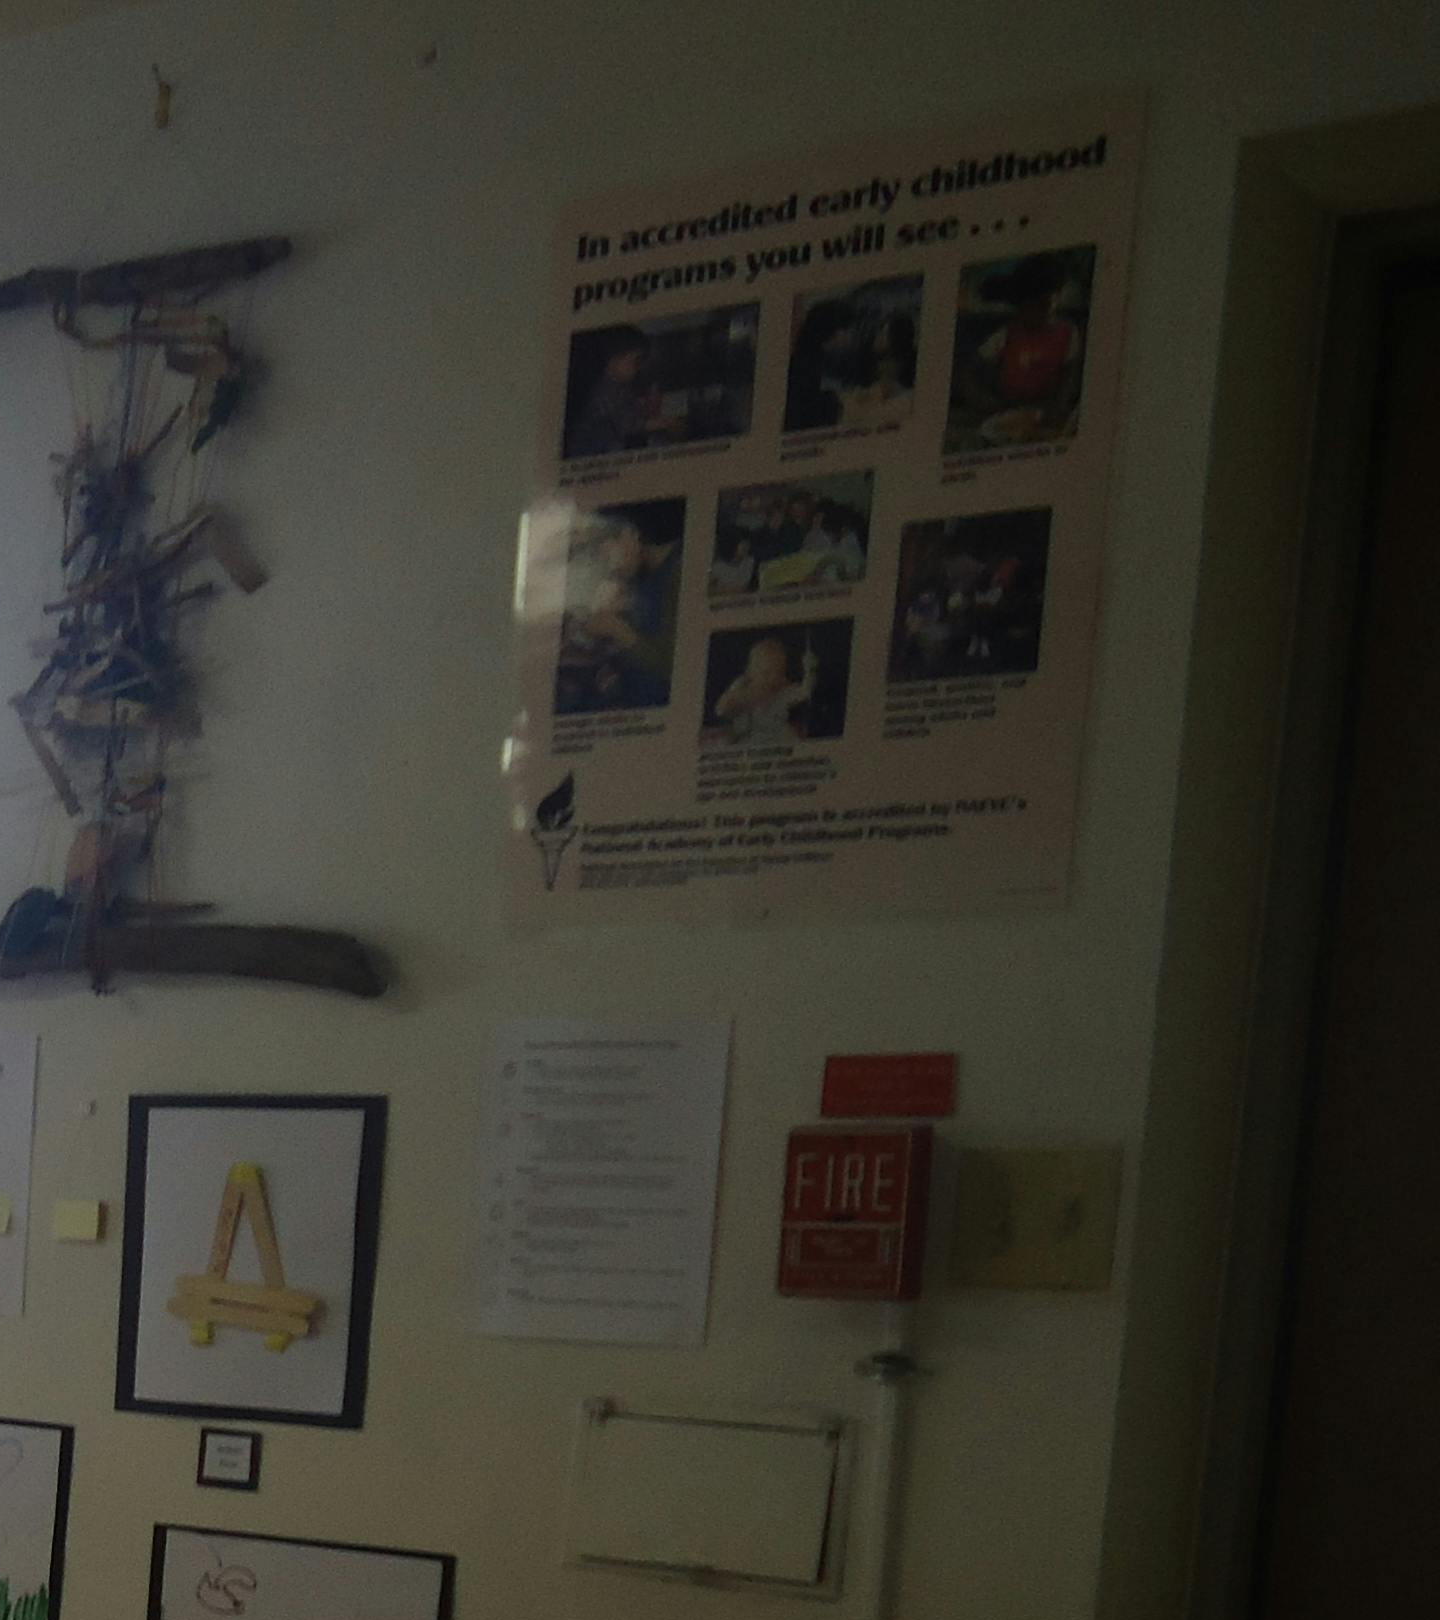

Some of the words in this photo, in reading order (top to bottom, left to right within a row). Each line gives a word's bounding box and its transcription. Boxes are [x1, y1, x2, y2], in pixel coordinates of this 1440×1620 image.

[576, 232, 610, 262] In
[620, 194, 799, 253] accredited
[809, 176, 901, 223] early
[911, 135, 1109, 198] childhood
[572, 257, 737, 311] programs
[746, 243, 812, 284] you
[822, 224, 885, 260] will
[895, 216, 959, 247] see
[793, 1152, 896, 1214] FIRE
